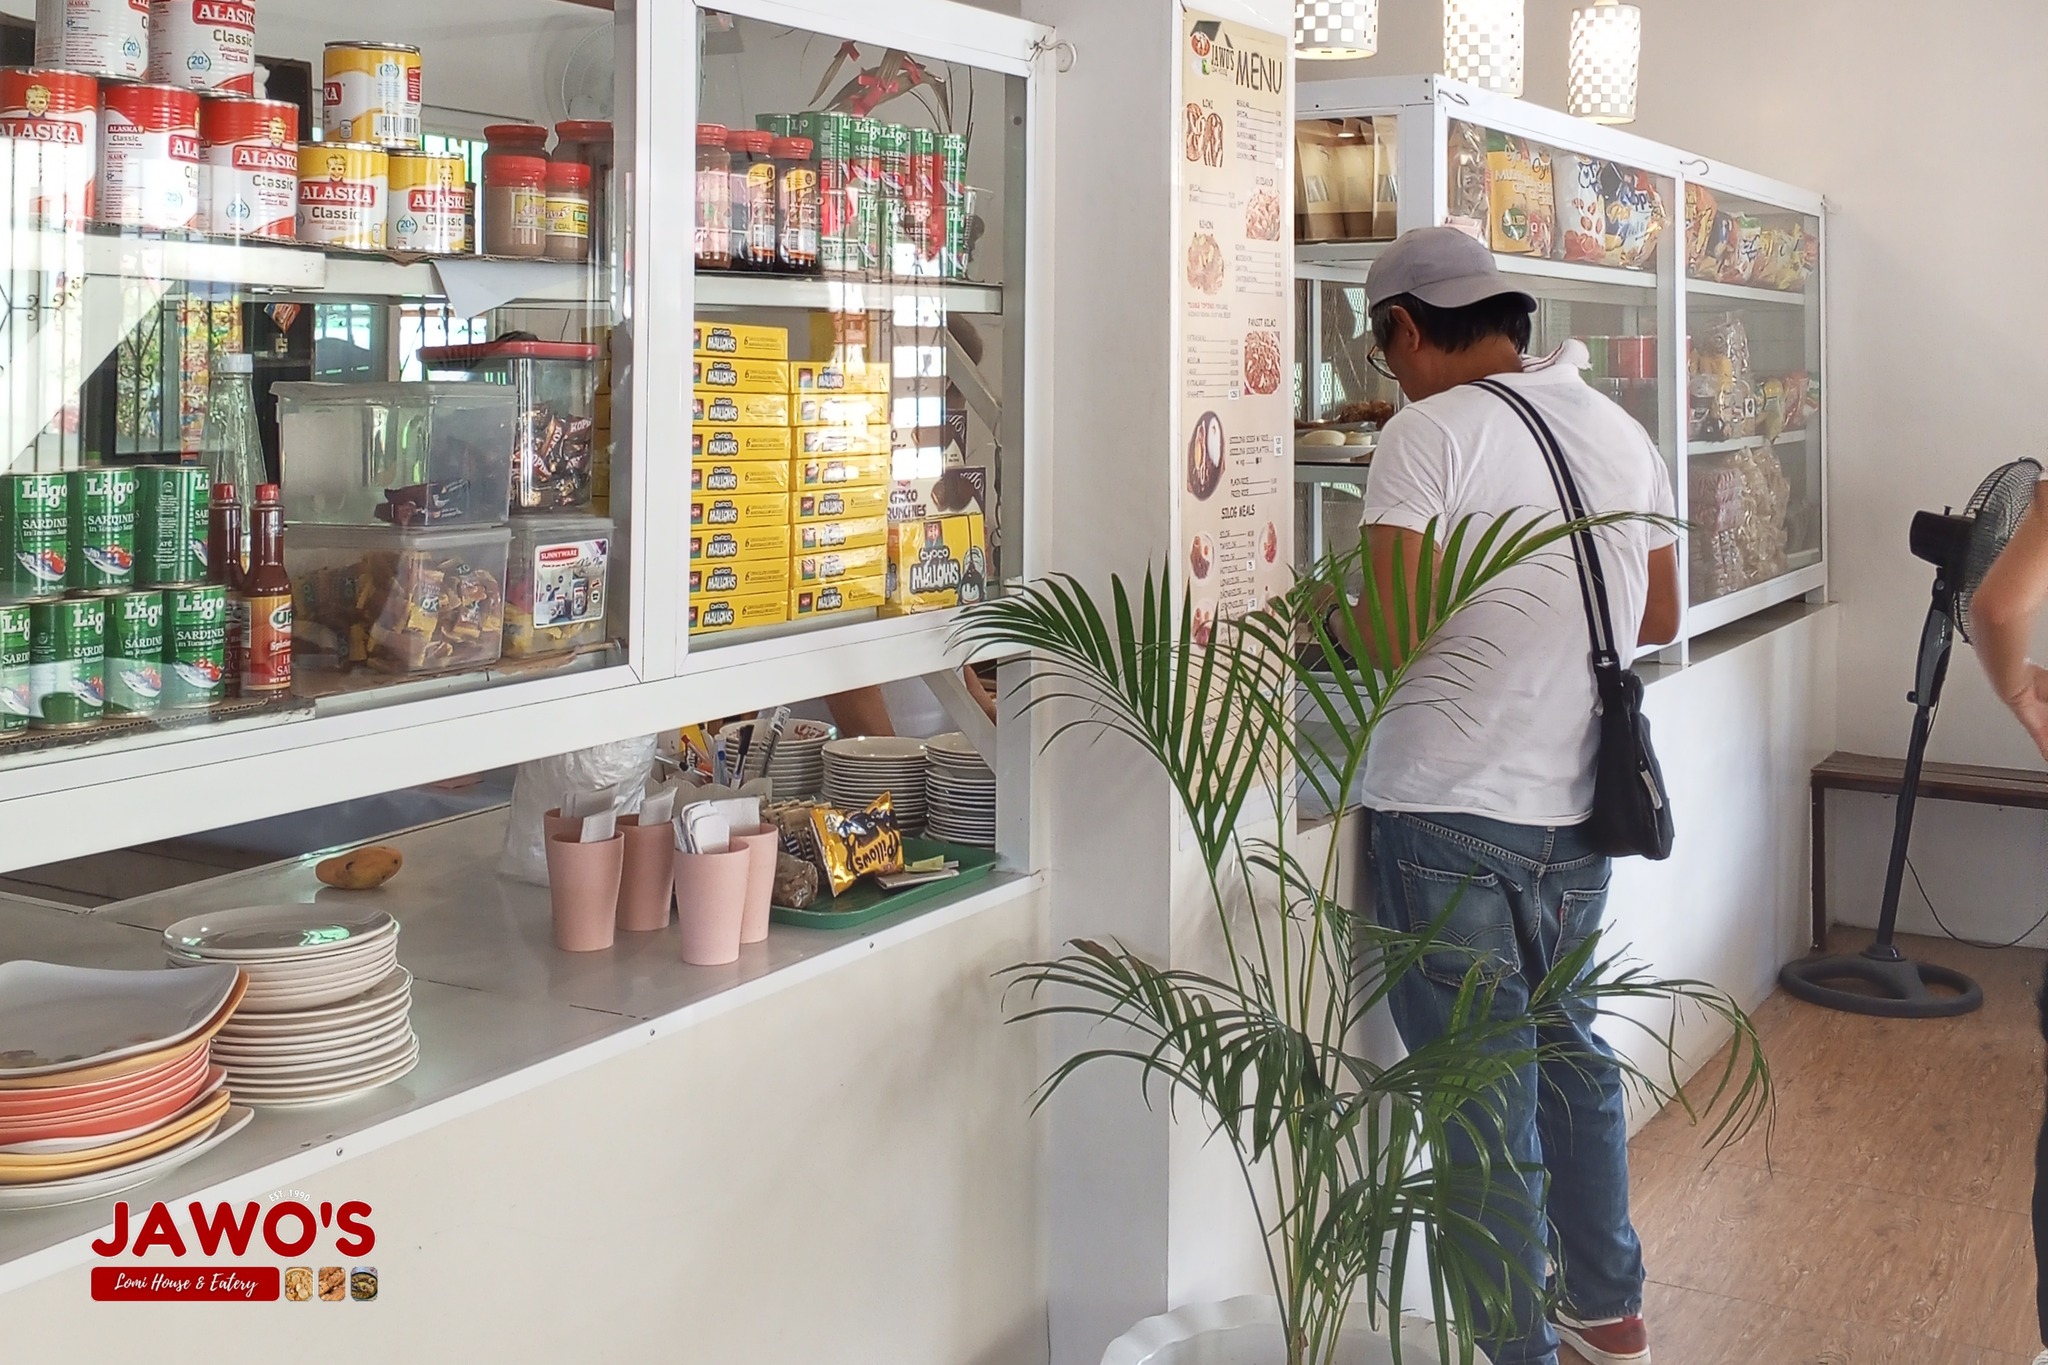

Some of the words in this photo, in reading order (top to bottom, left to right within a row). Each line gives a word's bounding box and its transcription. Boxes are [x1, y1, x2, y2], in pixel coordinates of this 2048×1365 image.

[212, 29, 252, 48] Classic
[191, 55, 207, 66] 20+
[1236, 50, 1282, 94] MENU
[252, 174, 293, 191] Classic
[301, 186, 372, 203] ALASKA
[312, 206, 359, 220] Classic
[426, 214, 461, 226] Clssic
[400, 219, 415, 228] 20+
[22, 478, 67, 508] Ligo
[87, 478, 133, 505] Ligo
[890, 489, 918, 504] CHOCO
[541, 548, 577, 559] SUNNYWARE
[921, 548, 949, 560] CHOCO
[177, 594, 224, 620] Ligo
[73, 608, 104, 635] Lig
[177, 628, 224, 640] SARDINES
[855, 830, 899, 870] Pillows
